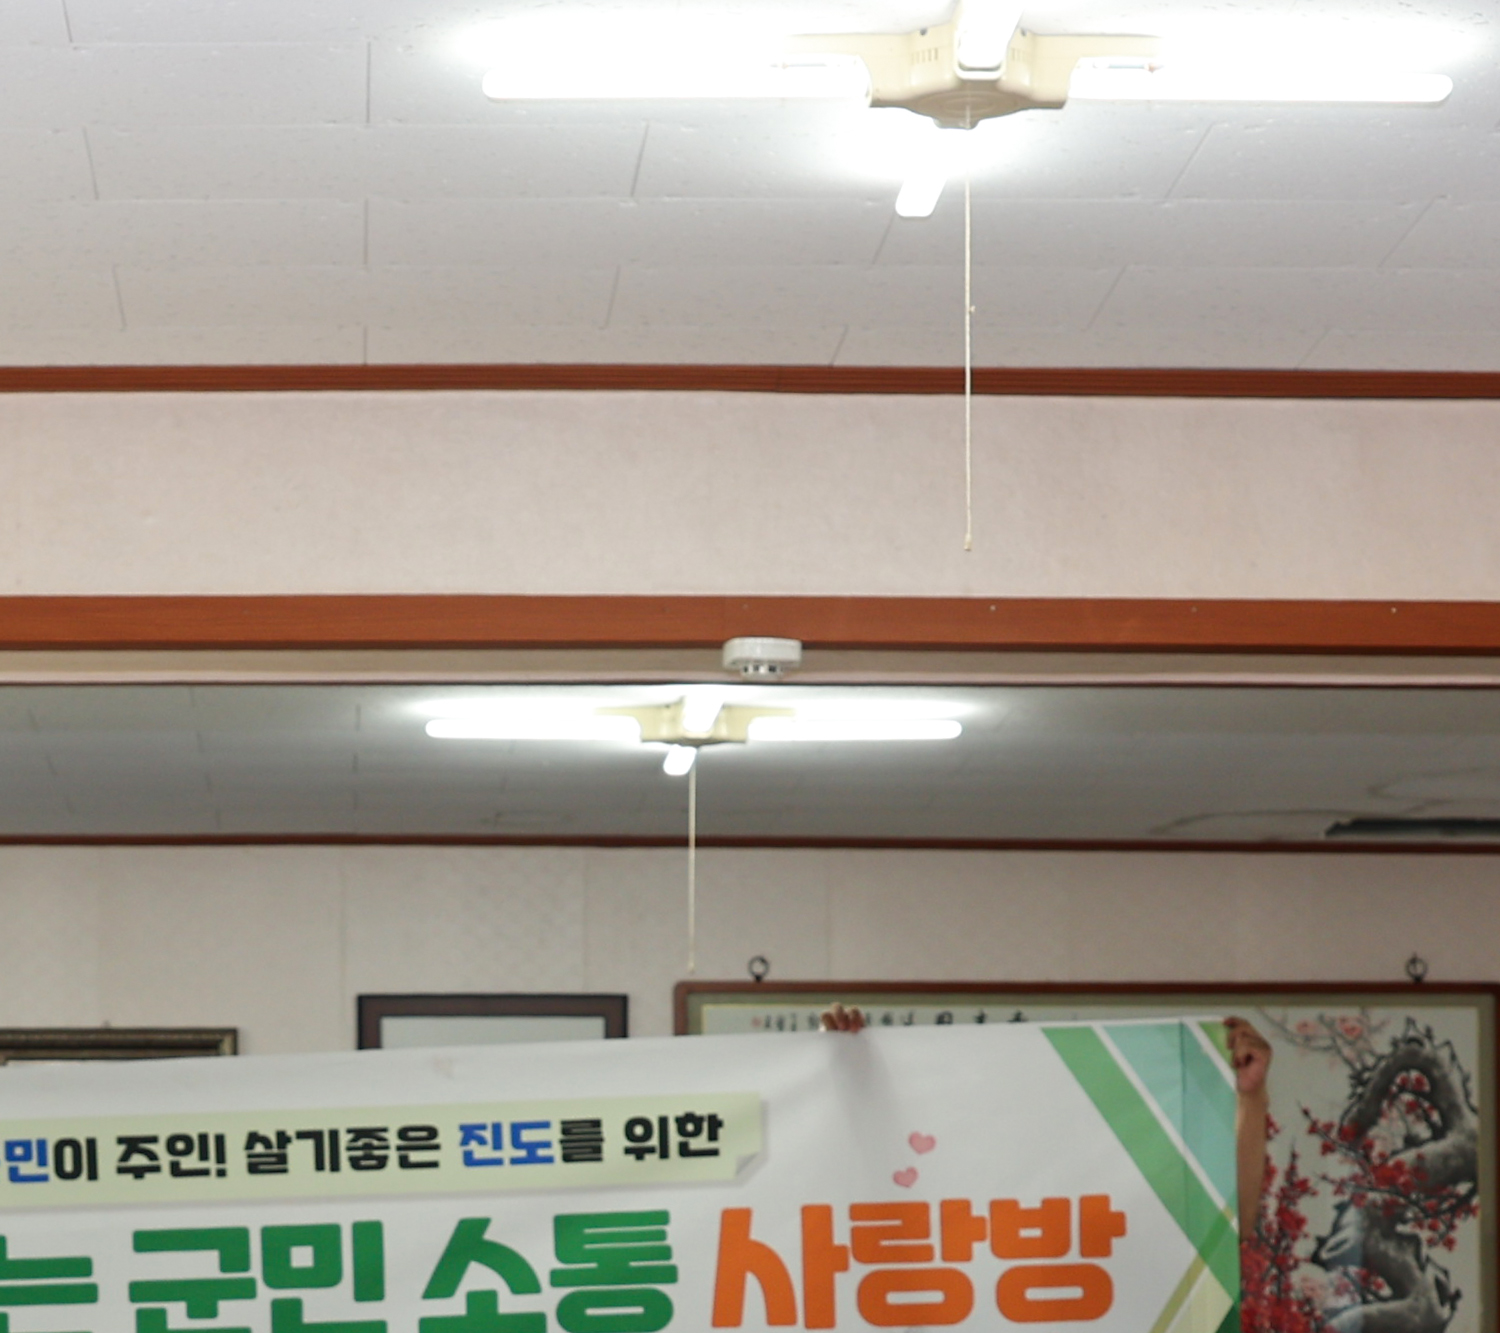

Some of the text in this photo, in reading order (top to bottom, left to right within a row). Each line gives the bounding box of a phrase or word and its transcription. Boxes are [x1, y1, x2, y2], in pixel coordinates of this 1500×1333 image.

[114, 1131, 229, 1181] 주인!
[242, 1124, 443, 1176] 살기좋은
[457, 1117, 606, 1170] 진도를
[621, 1111, 724, 1162] 위한
[710, 1194, 1127, 1330] 사랑방
